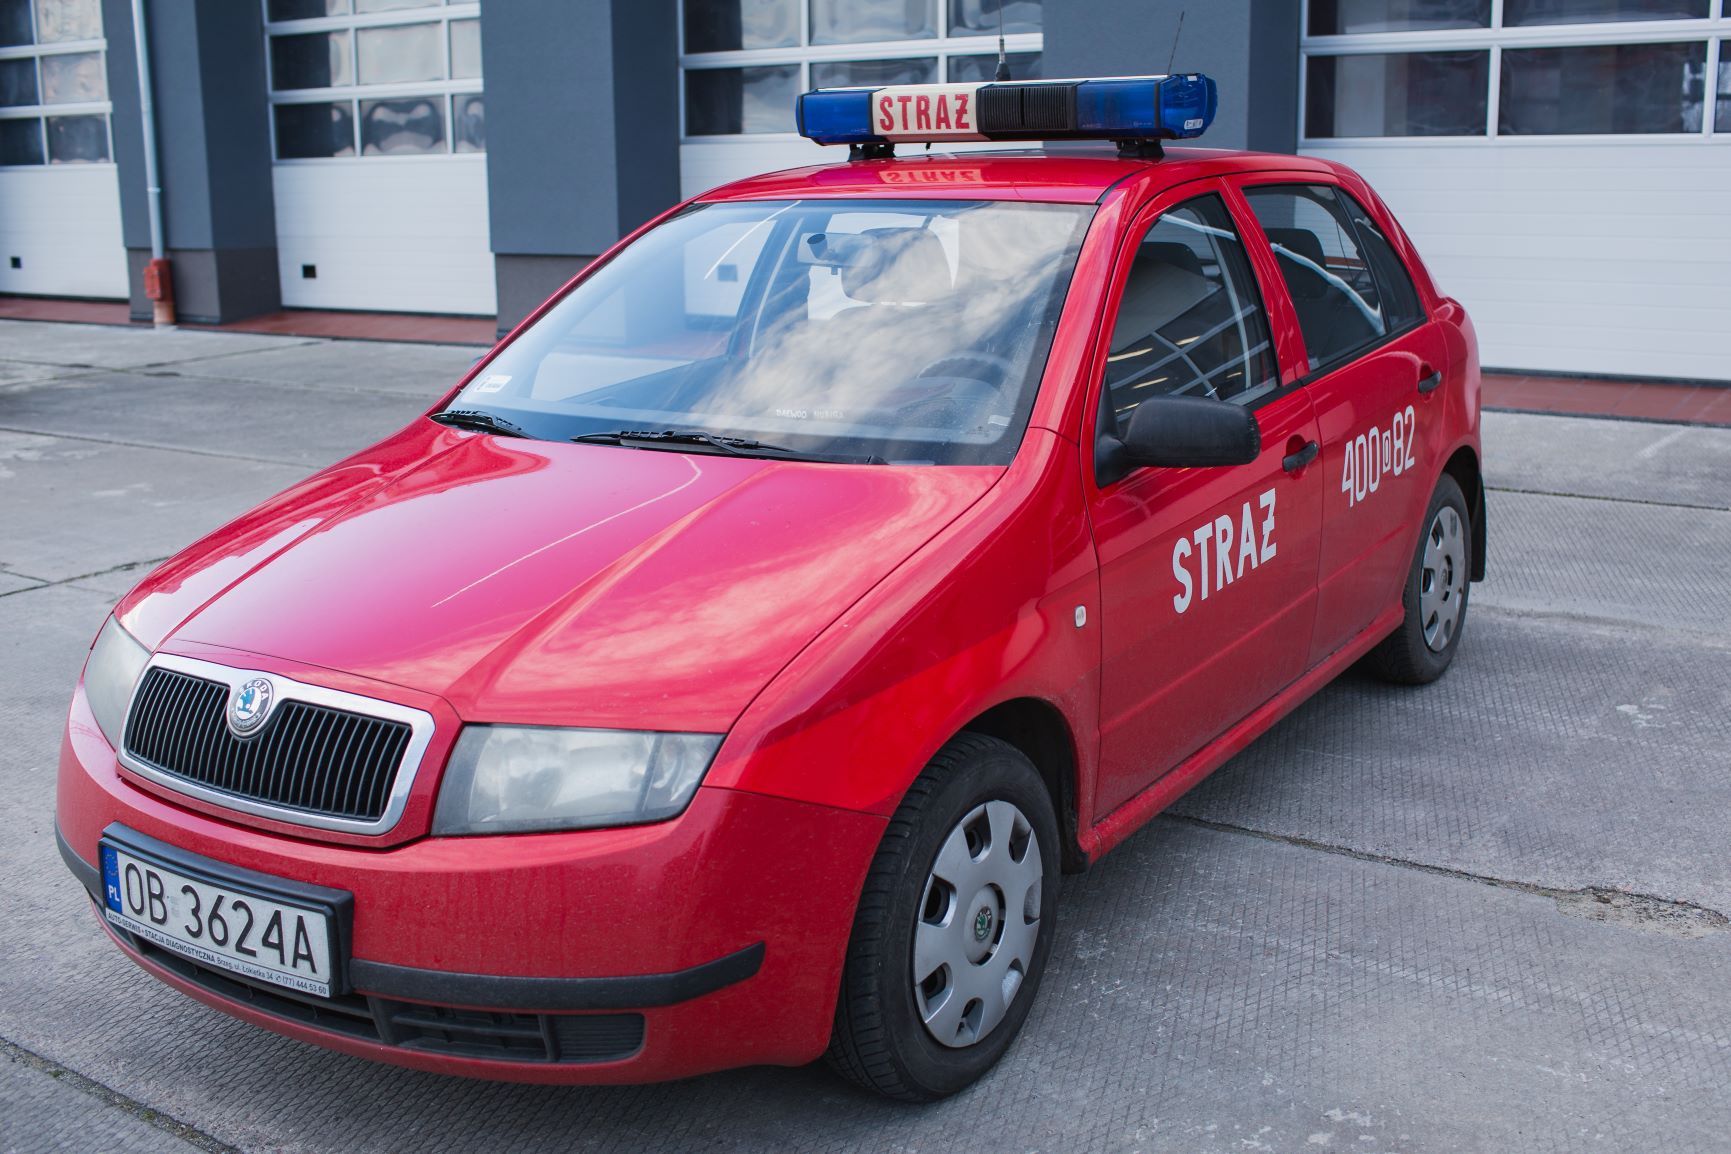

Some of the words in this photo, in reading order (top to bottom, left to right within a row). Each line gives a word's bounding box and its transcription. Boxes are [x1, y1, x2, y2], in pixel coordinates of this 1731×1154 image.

[108, 884, 121, 902] PL
[124, 862, 168, 925] OB
[180, 884, 318, 974] 3624A
[144, 929, 166, 944] STACJA
[165, 938, 216, 963] DIAGNOSTYCZNA
[308, 983, 318, 992] 53
[318, 985, 327, 995] 60
